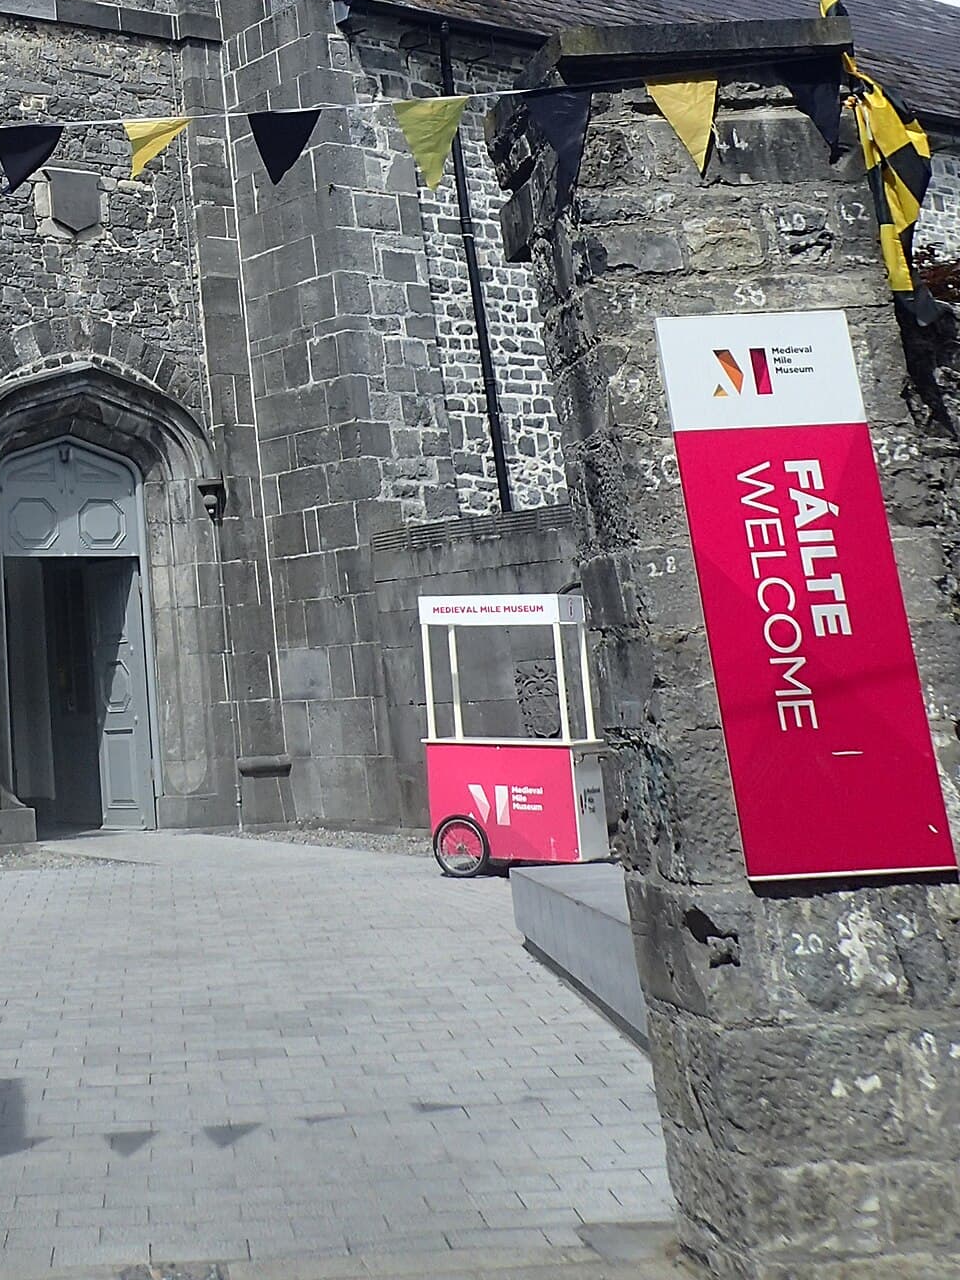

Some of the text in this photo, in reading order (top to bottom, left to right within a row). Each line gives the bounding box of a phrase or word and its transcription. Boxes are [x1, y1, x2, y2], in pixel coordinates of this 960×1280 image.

[772, 345, 813, 355] Medieval
[773, 357, 792, 365] Mile
[775, 366, 814, 374] Museum
[783, 459, 853, 637] FÁILTE
[737, 461, 819, 732] WELCOME
[432, 606, 478, 614] MEDIEVAL
[503, 605, 544, 613] MUSEUM
[511, 785, 544, 795] Medieval
[511, 794, 527, 802] Mile
[512, 802, 544, 811] Museum
